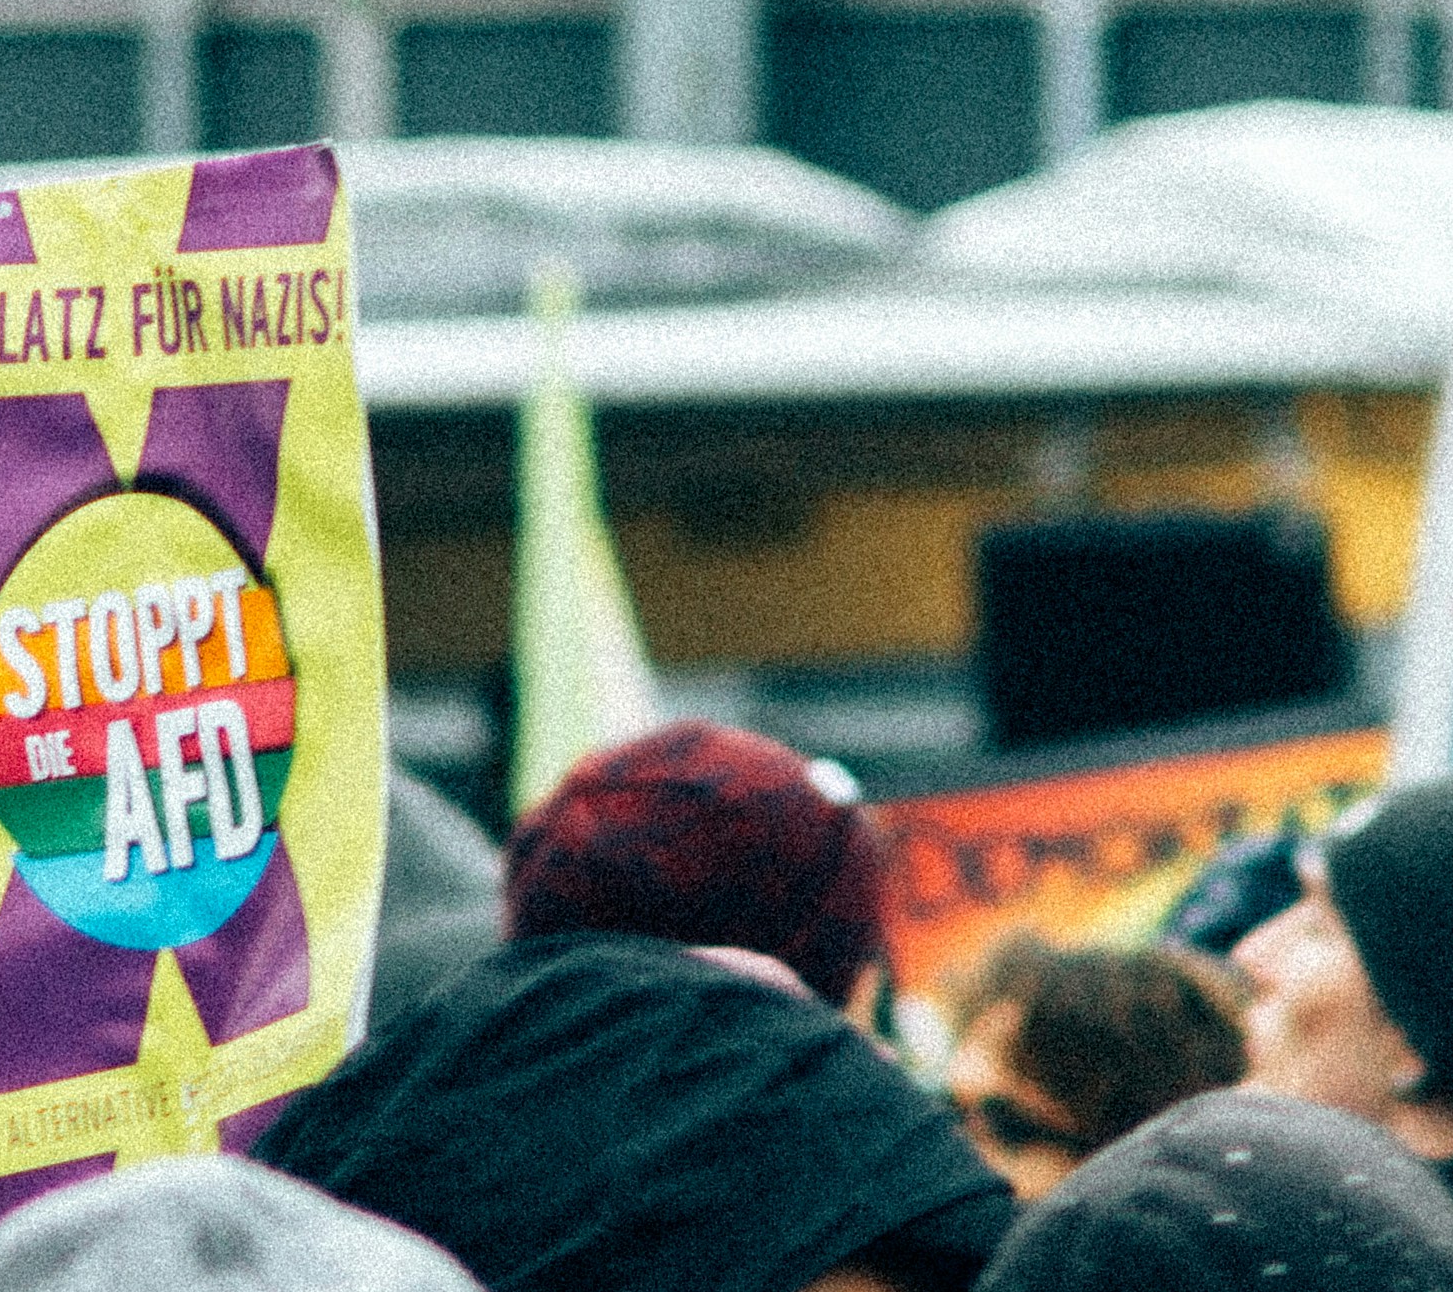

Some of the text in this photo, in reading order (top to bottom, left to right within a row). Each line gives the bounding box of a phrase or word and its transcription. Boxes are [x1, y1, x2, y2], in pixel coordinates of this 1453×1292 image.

[131, 266, 211, 358] FÜR
[220, 267, 346, 352] NAZIS!
[24, 698, 265, 882] DIE AFD
[7, 1080, 173, 1148] ALTERNATIVE
